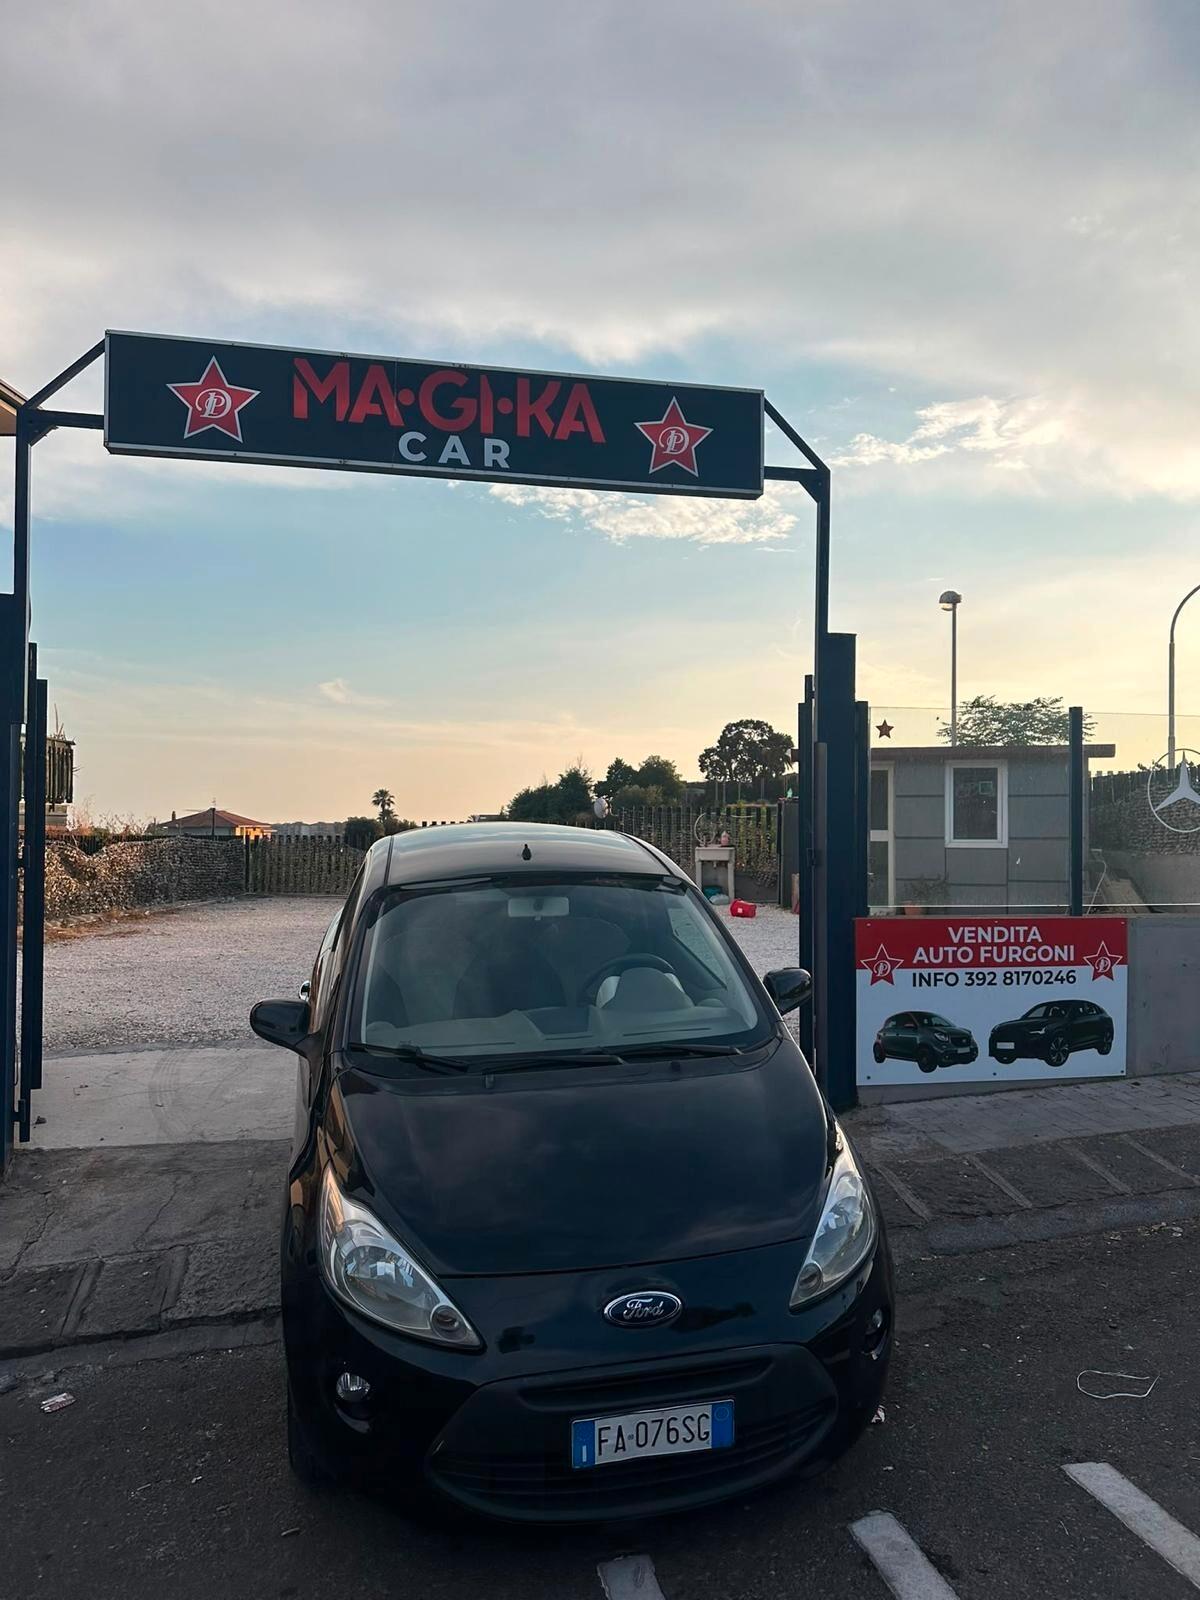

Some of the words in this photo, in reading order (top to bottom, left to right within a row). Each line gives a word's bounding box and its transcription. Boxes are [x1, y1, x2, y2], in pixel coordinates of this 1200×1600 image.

[398, 431, 510, 469] CAR
[948, 926, 1042, 944] VENDITA
[912, 946, 974, 965] AUTO
[980, 944, 1075, 963] FURGONI
[912, 972, 959, 988] INFO
[964, 971, 998, 987] 392
[1002, 969, 1077, 986] 8170246
[623, 1298, 664, 1319] Ford
